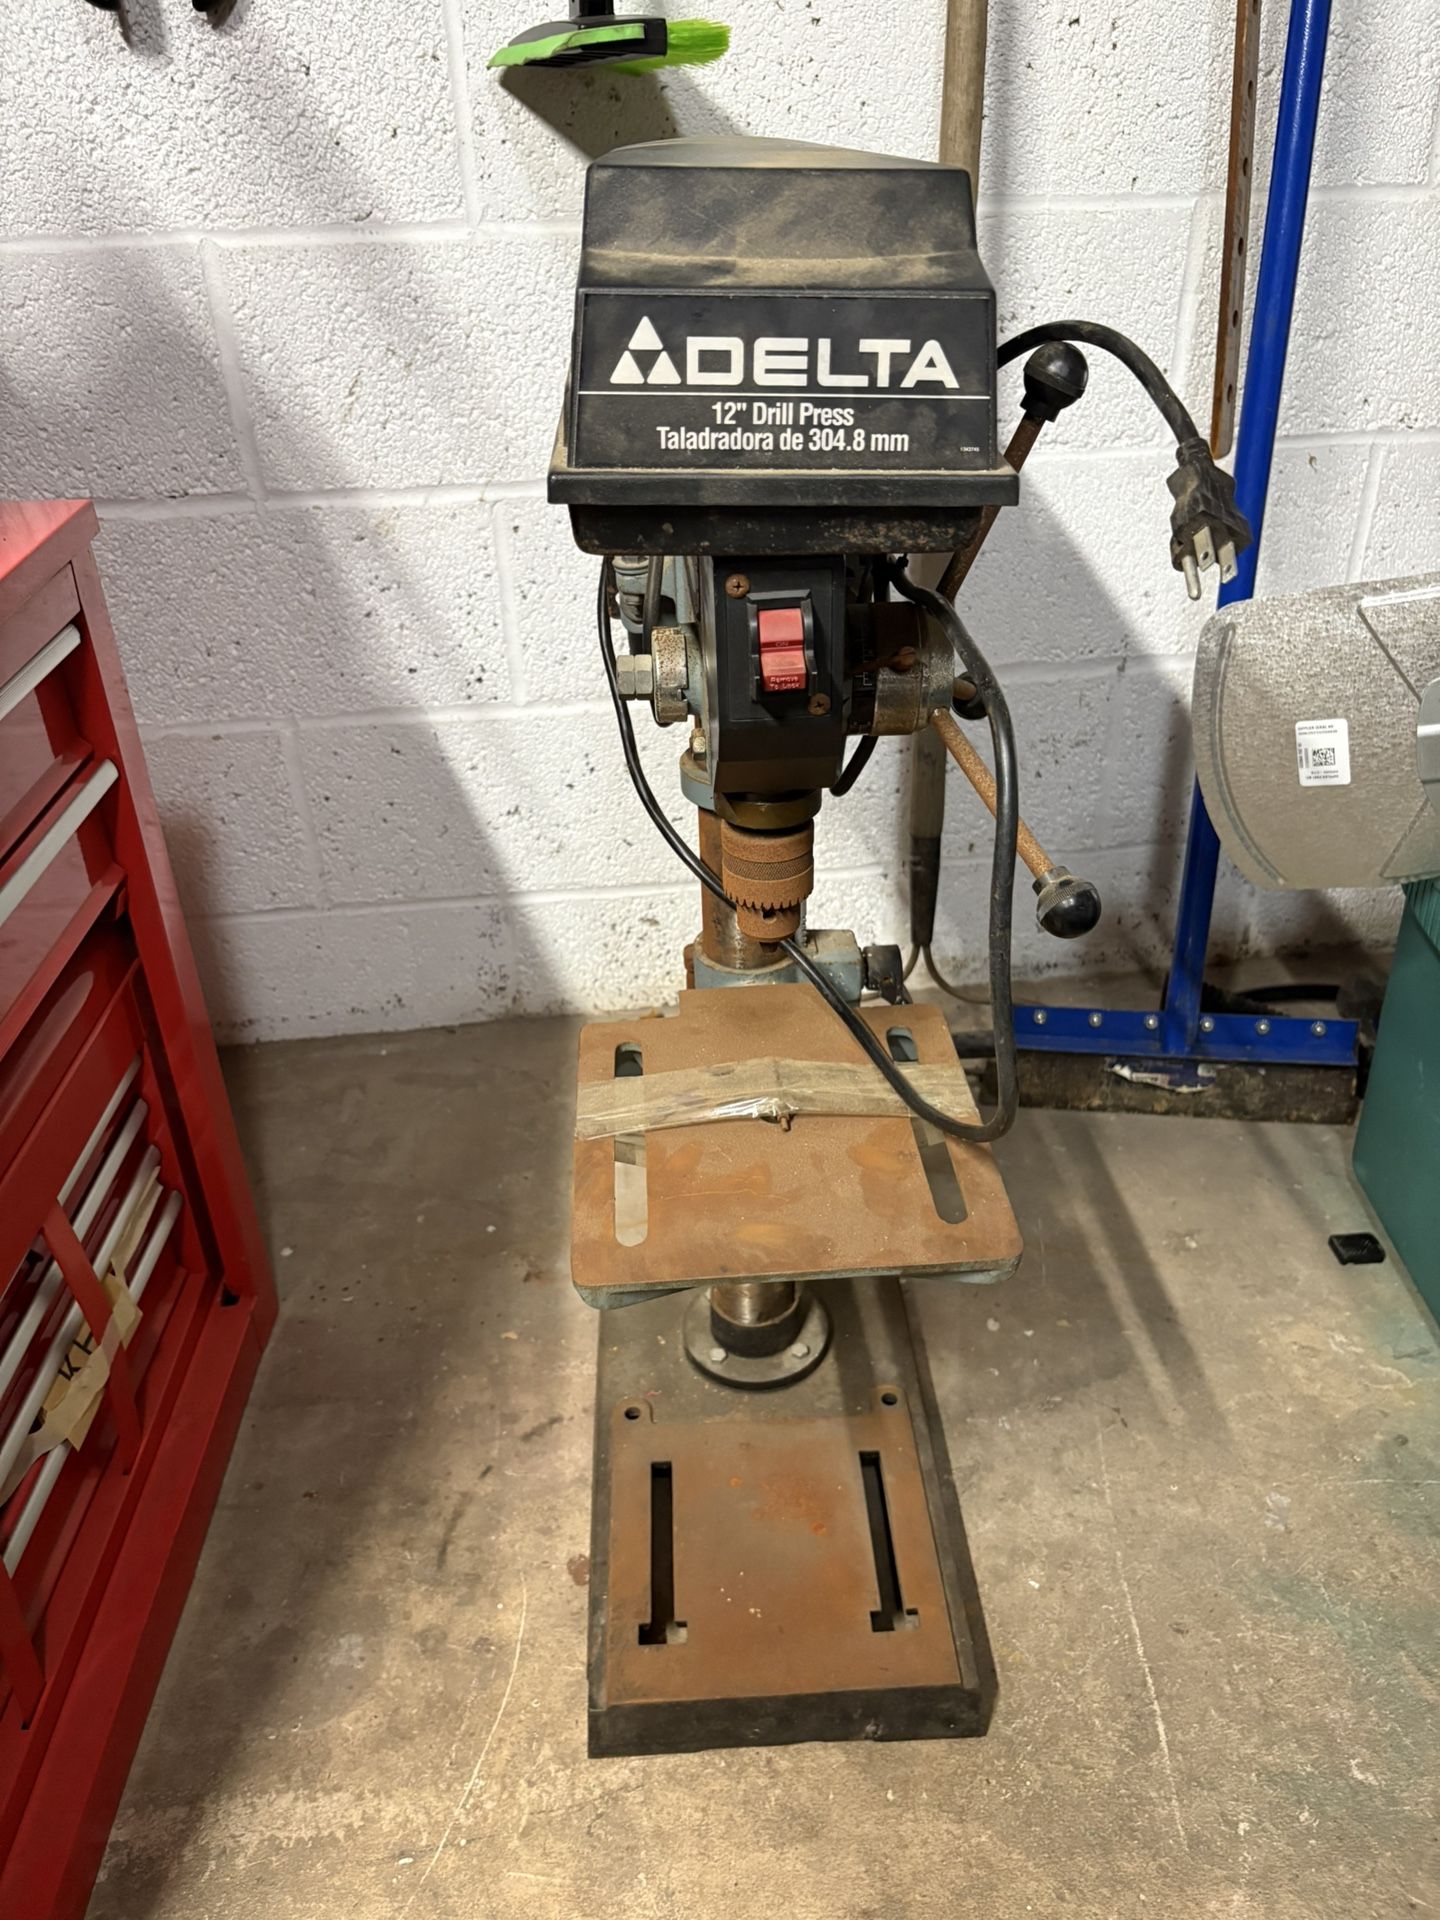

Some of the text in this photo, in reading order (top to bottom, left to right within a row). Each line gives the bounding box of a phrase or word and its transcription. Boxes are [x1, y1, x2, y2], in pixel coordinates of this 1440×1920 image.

[686, 336, 960, 389] DELTA
[711, 401, 855, 426] 12" Drill Press
[656, 425, 909, 452] Taladradora de 304.8 mm
